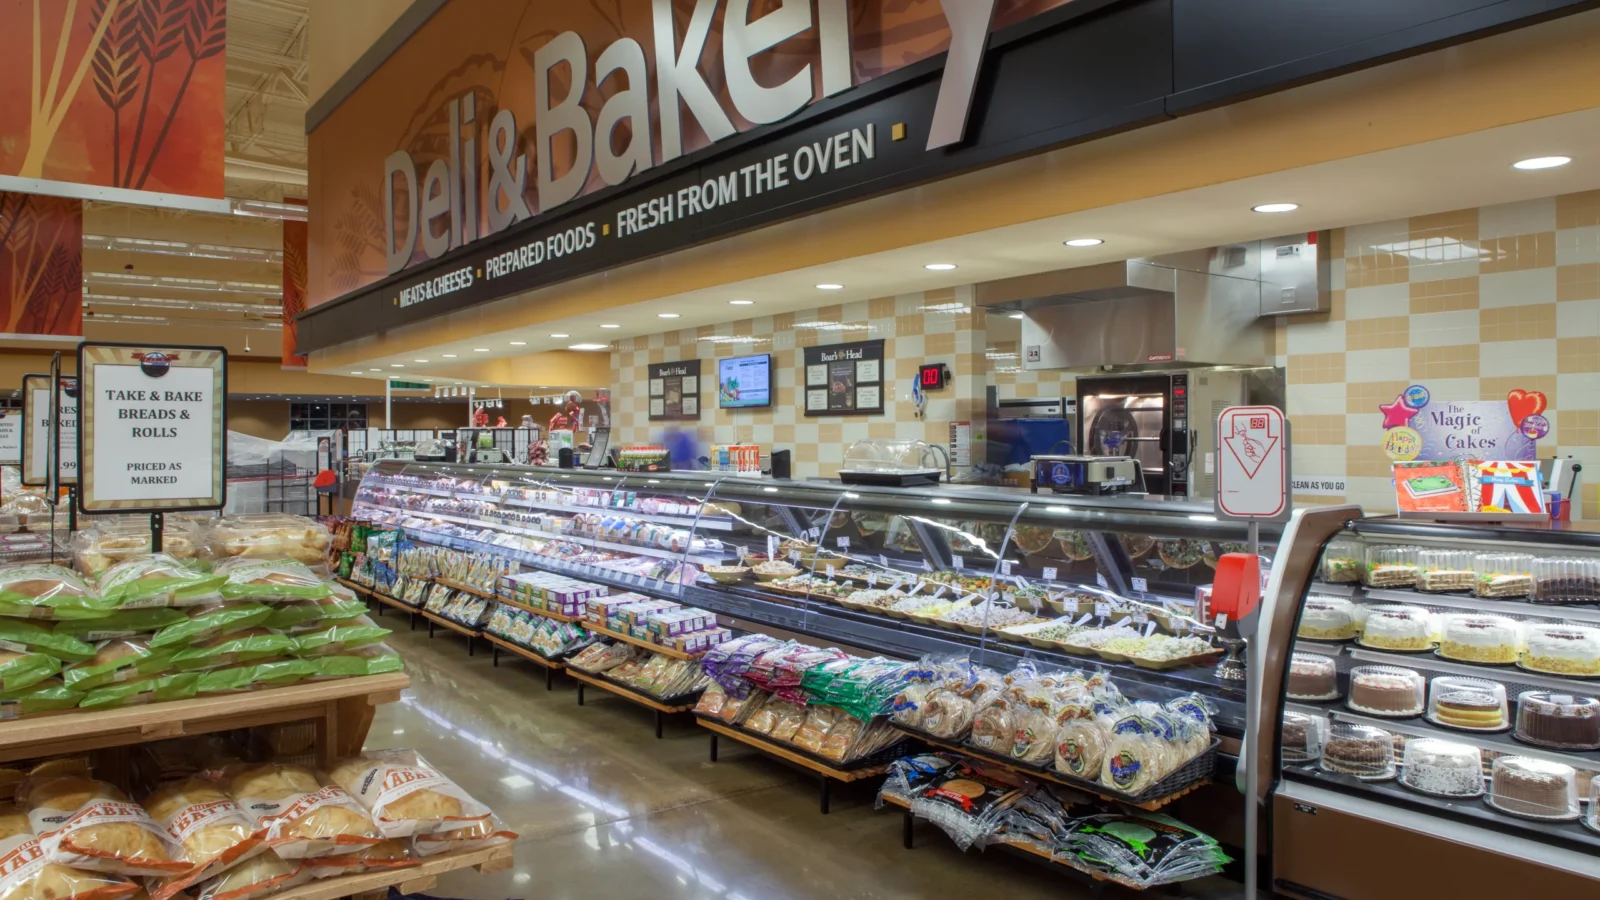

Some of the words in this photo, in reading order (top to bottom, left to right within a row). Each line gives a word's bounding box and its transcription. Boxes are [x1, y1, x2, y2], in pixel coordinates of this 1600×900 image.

[383, 92, 478, 276] Deli
[487, 108, 532, 232] &
[616, 193, 674, 238] FRESH
[677, 171, 738, 219] FROM
[740, 153, 789, 198] THE
[793, 123, 876, 181] OVEN
[486, 240, 545, 280] PREPARED
[547, 221, 596, 261] FOODS
[433, 266, 473, 297] CHEESES
[821, 352, 838, 361] Boar's
[846, 349, 863, 360] Head
[675, 366, 687, 375] Head
[105, 390, 146, 401] TAKE
[149, 390, 161, 402] &
[164, 391, 203, 402] BAKE
[118, 408, 177, 419] BREADS
[179, 409, 191, 420] &
[1448, 405, 1465, 413] The
[1430, 411, 1481, 430] Magic
[132, 427, 178, 438] ROLLS
[1471, 426, 1482, 434] of
[1445, 433, 1497, 449] Cakes
[126, 462, 166, 471] PRICED
[168, 462, 182, 471] AS
[131, 475, 178, 484] MARKED
[1311, 481, 1319, 490] AS
[1320, 481, 1334, 490] YOU
[1335, 482, 1345, 490] GO
